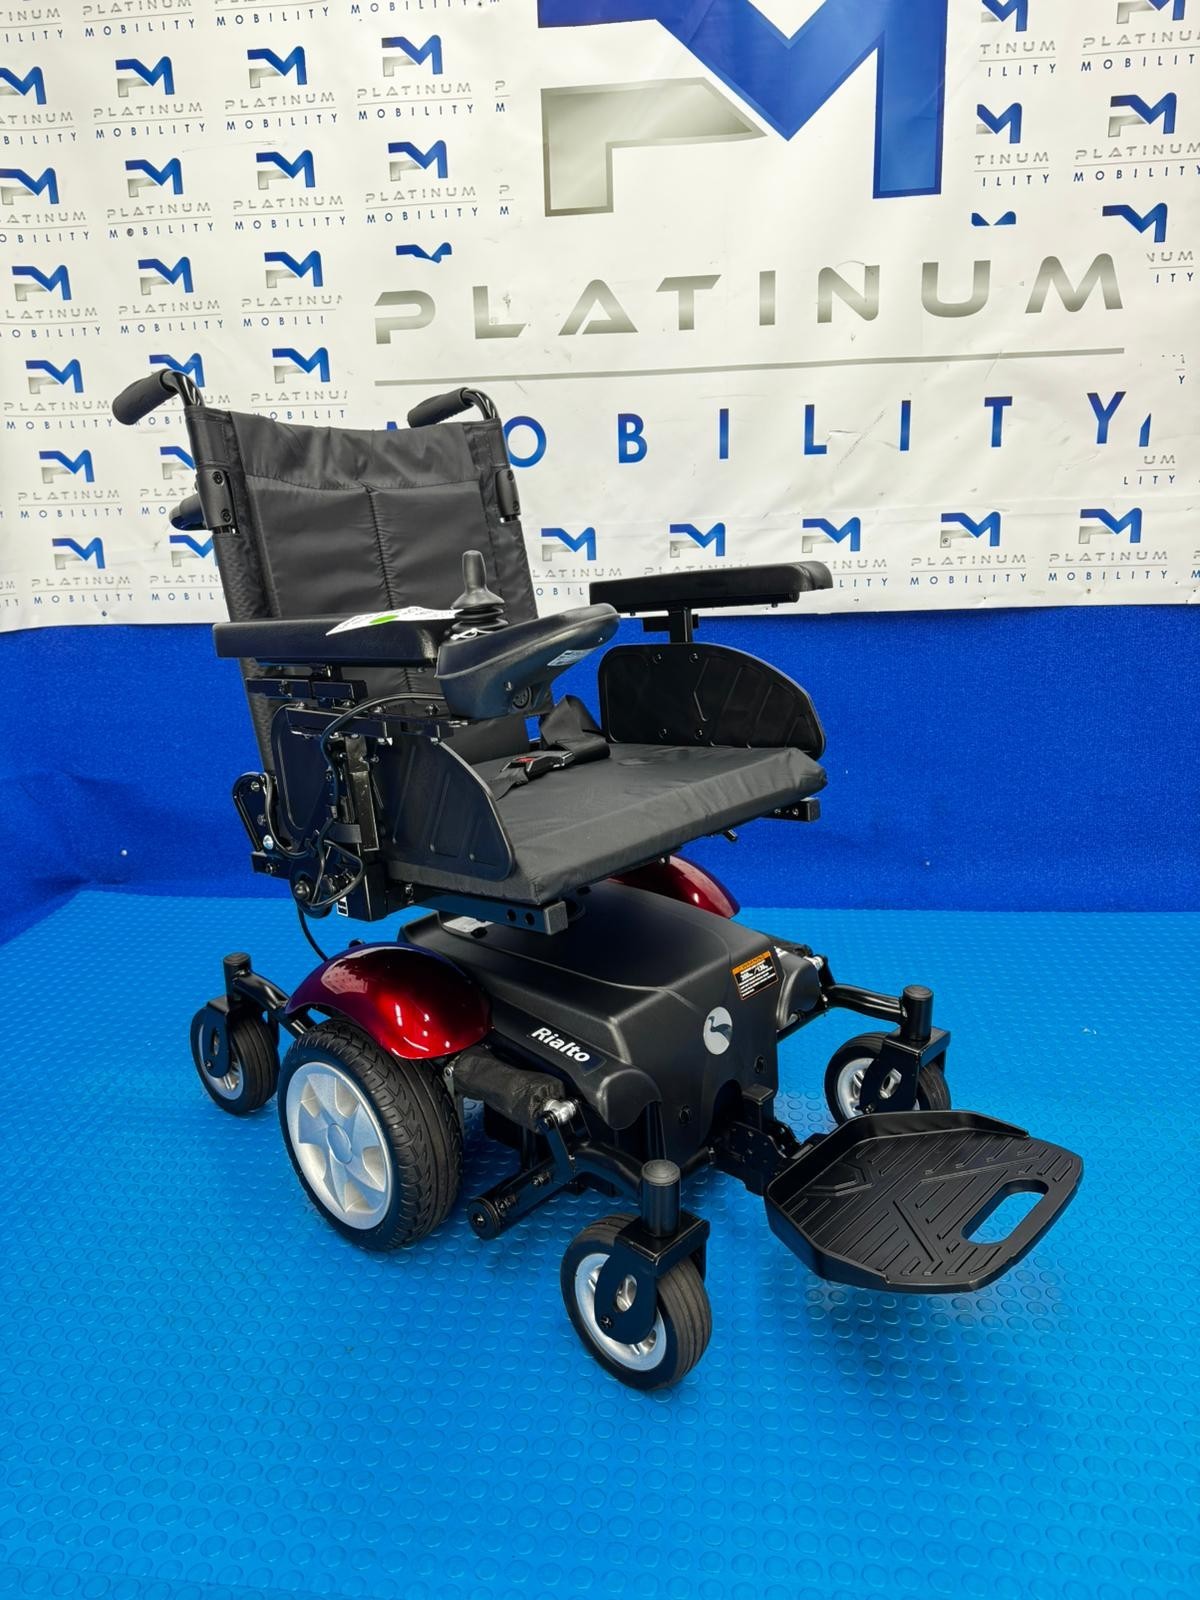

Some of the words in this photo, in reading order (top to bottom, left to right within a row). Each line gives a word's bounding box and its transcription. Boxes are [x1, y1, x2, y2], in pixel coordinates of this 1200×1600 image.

[82, 0, 191, 15] PLATINUM
[216, 7, 329, 26] MOBILITY
[85, 19, 195, 37] MOBILITY
[1082, 30, 1200, 48] PLATINU
[357, 82, 472, 99] PLATINUM
[225, 91, 335, 110] PLATINUM
[93, 102, 203, 118] PLATINUM
[358, 104, 474, 120] MOBILITY
[226, 113, 338, 131] MOBILITY
[96, 123, 208, 139] MOBILITY
[365, 185, 477, 203] PLATINUM
[106, 201, 211, 218] PLATINUM
[233, 195, 344, 210] PLATINUM
[367, 206, 478, 224] MOBILITY
[234, 216, 347, 231] MOBILITY
[374, 252, 1125, 345] PLATINUM
[118, 299, 222, 315] PLATINUM
[0, 326, 102, 339] OBILITY
[120, 319, 225, 335] MOBILITY
[3, 400, 111, 412] PLATINUM
[6, 418, 113, 430] MOBILITY
[386, 391, 1127, 468] OBILITY
[17, 489, 120, 501] PLATINUM
[20, 506, 123, 519] MOBILITY
[910, 553, 1027, 567] PLATINUM
[1049, 550, 1169, 563] PLATINUM
[31, 575, 131, 588] PLATINUM
[909, 573, 1027, 586] MOBILITY
[1048, 569, 1168, 582] MOBILITY
[34, 592, 134, 605] MOBILITY
[531, 1027, 590, 1062] Rialto
